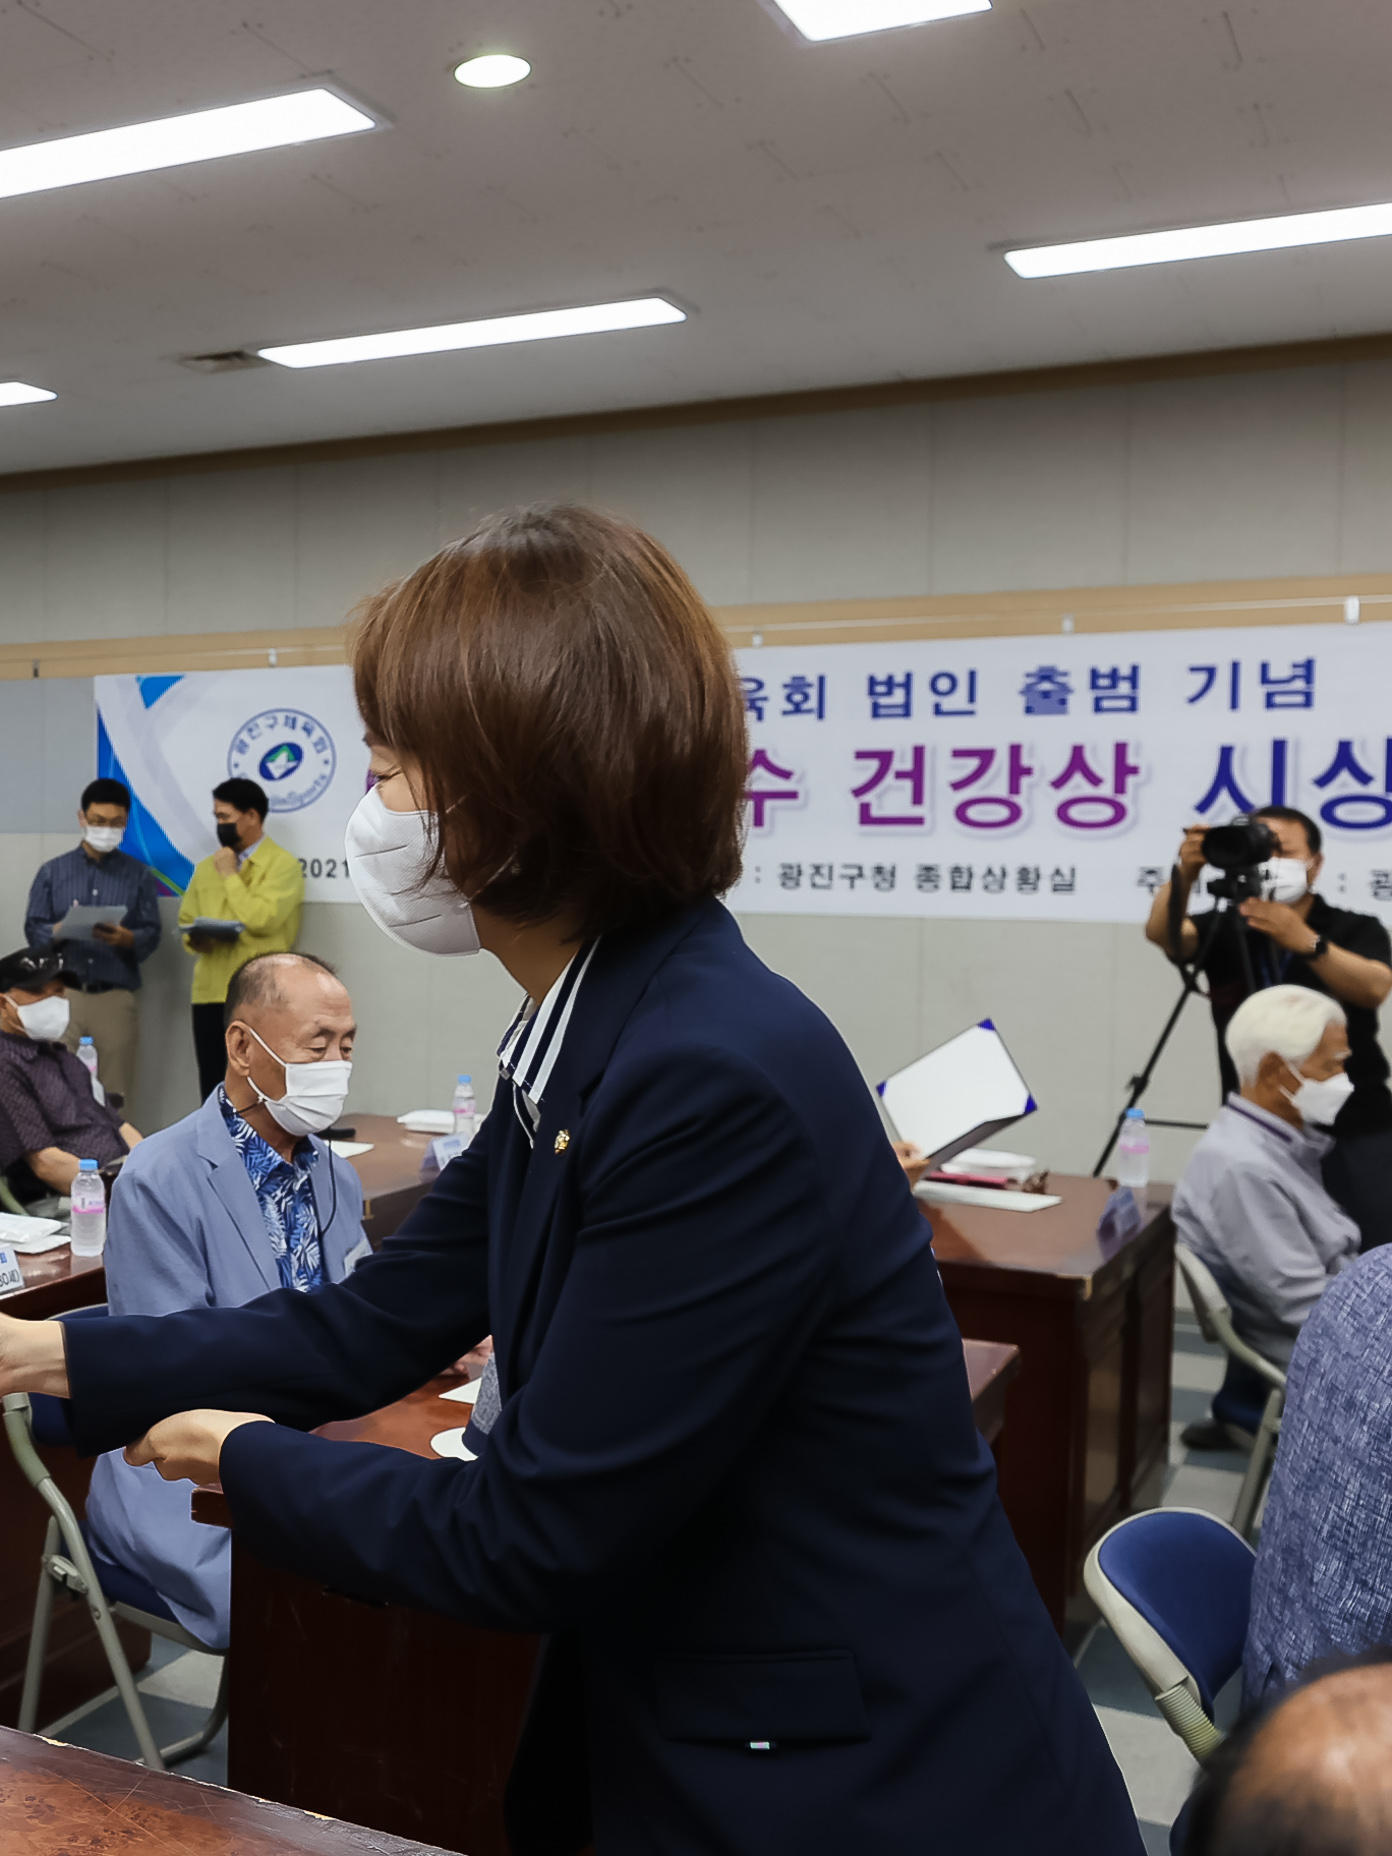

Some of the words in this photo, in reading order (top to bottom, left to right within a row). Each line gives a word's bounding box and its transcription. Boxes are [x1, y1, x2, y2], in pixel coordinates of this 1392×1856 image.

[868, 668, 976, 719] 법인
[1018, 664, 1140, 716] 출범
[1187, 657, 1315, 711] 기념
[851, 741, 1140, 830] 건강상
[778, 862, 897, 891] 광진구청
[916, 863, 1076, 895] 종합상황실
